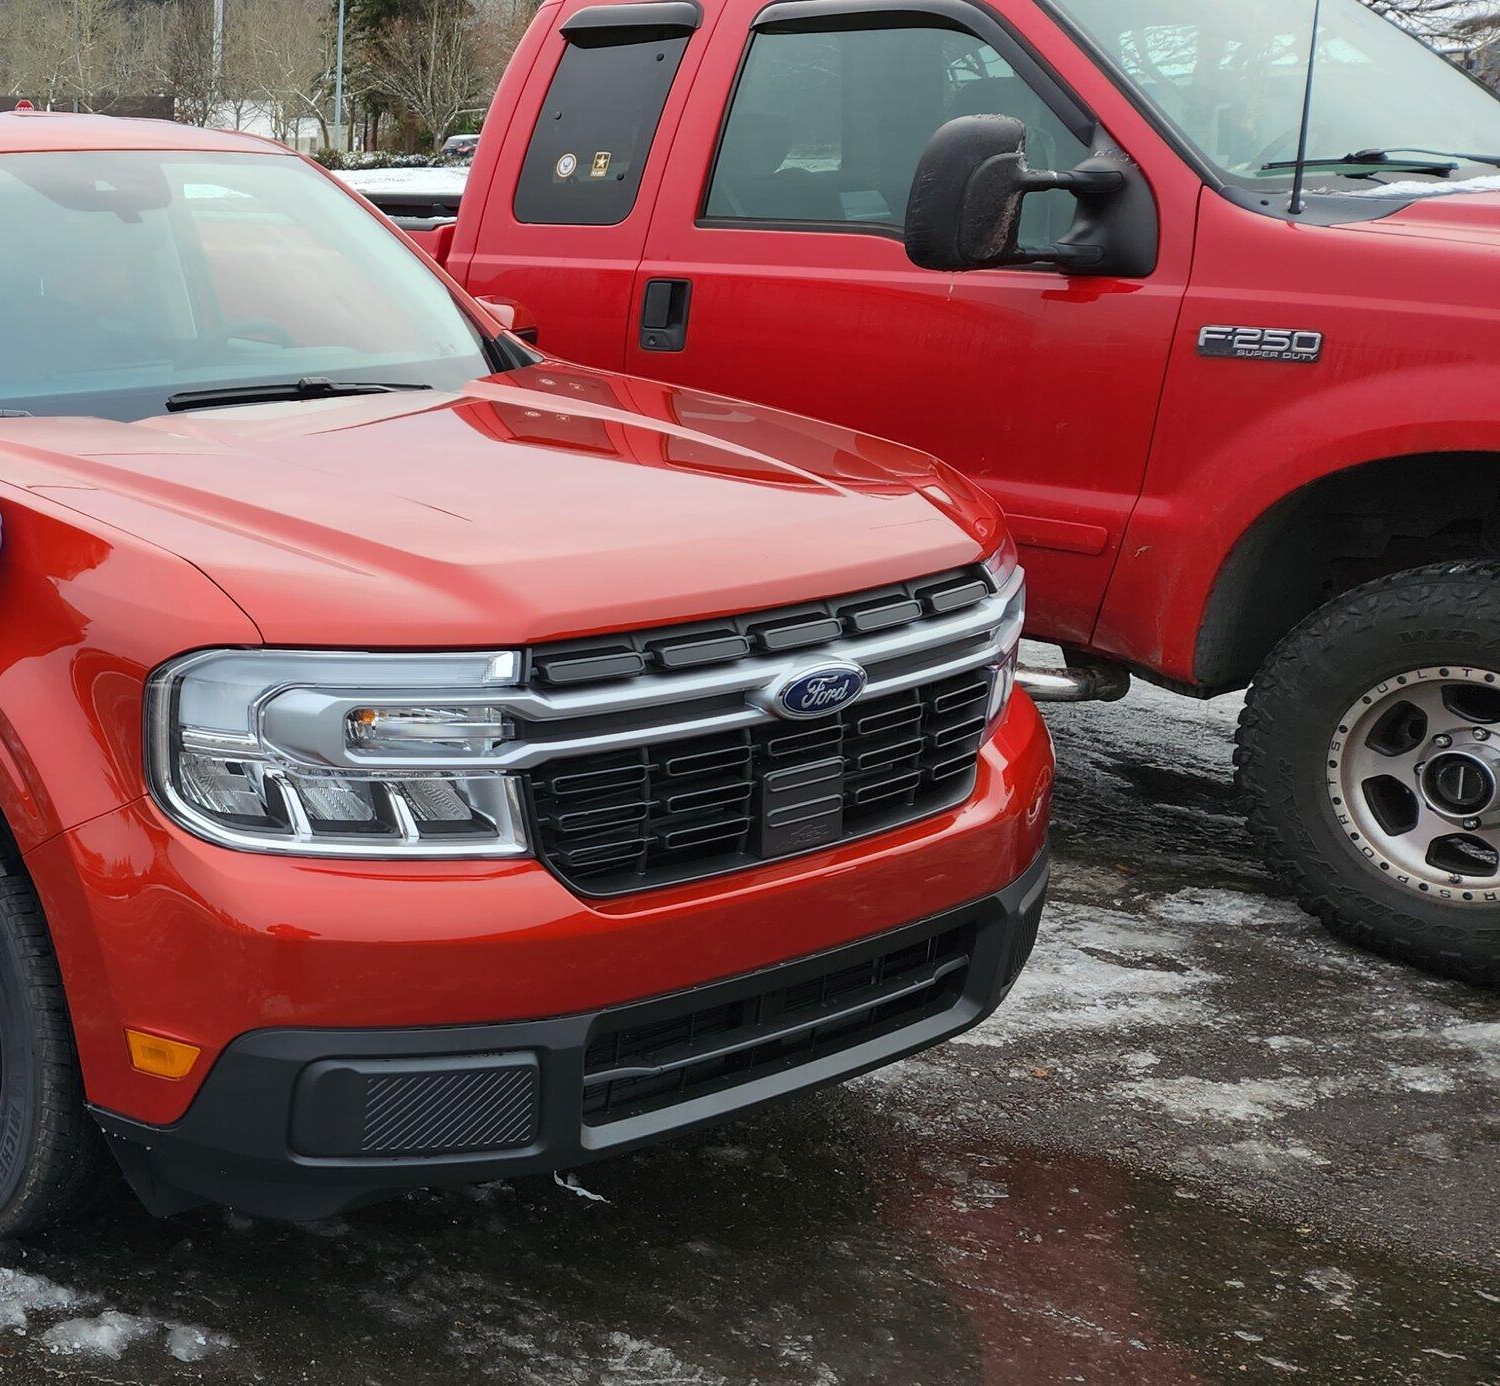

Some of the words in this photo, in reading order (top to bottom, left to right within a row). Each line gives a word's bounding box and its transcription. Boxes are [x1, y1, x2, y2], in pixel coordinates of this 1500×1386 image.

[1198, 326, 1322, 353] F-250
[1236, 349, 1278, 358] SUPER
[1282, 352, 1318, 360] DUTY
[801, 675, 849, 709] Ford
